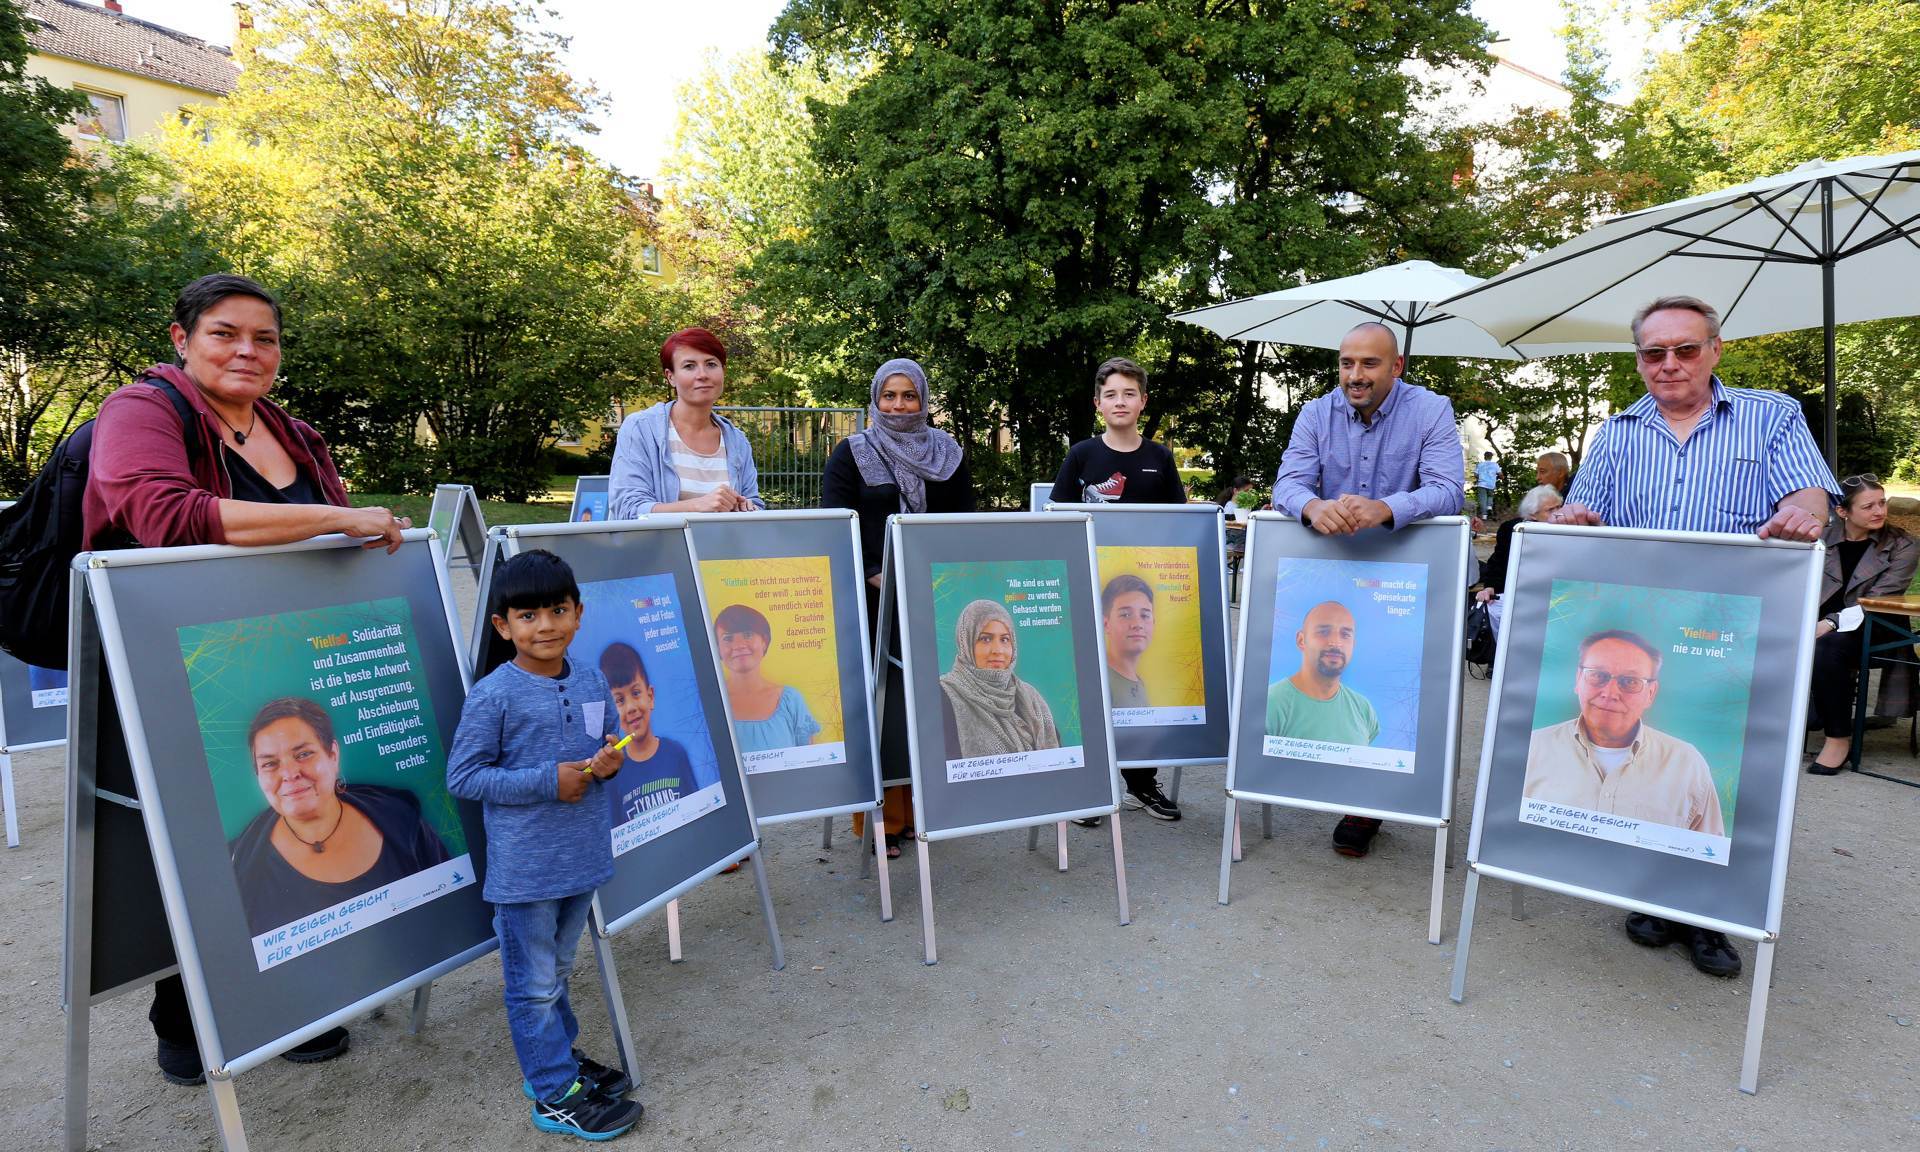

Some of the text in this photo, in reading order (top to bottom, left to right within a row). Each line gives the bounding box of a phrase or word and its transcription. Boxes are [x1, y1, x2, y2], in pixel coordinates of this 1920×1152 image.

[749, 577, 759, 586] ist
[760, 577, 777, 585] nicht
[1022, 578, 1036, 588] sind
[1045, 578, 1060, 587] wert
[1381, 580, 1404, 589] macht
[1405, 580, 1417, 590] die
[754, 591, 770, 599] oder
[794, 588, 810, 597] auch
[812, 587, 823, 596] die
[1373, 591, 1416, 603] Speisekarte
[769, 601, 824, 612] unendlich vielen
[1039, 603, 1062, 613] werden
[1019, 618, 1031, 627] soll
[352, 623, 403, 643] Solidarität
[644, 628, 659, 642] jeder
[786, 626, 826, 637] dazwischen
[1720, 631, 1734, 642] ist
[780, 641, 796, 650] sind
[1673, 642, 1688, 654] nie
[1690, 646, 1703, 655] zu
[313, 642, 407, 670] und Zusammenhalt
[310, 660, 411, 691] ist die beste Antwort
[330, 692, 347, 707] auf
[358, 698, 420, 721] Abschiebung
[343, 714, 424, 745] und Einfältigkeit,
[377, 735, 428, 756] besonders
[1284, 740, 1313, 749] ZEIGEN
[1315, 743, 1351, 753] GESICHT
[749, 751, 785, 762] GESICHT
[951, 754, 1029, 770] WIR ZEIGEN GESICHT
[634, 788, 675, 814] TYRANNO
[613, 828, 626, 840] WIR
[627, 818, 651, 833] ZEIGEN
[652, 804, 680, 823] GESICHT
[1528, 802, 1640, 831] WIR ZEIGEN GESICHT
[1526, 813, 1598, 835] FÜR VIELFALT.
[616, 840, 630, 853] FÜR
[263, 930, 286, 947] WIR
[290, 911, 336, 937] ZEIGEN
[339, 889, 390, 917] GESICHT
[266, 921, 353, 965] FÜR VIELFALT.
